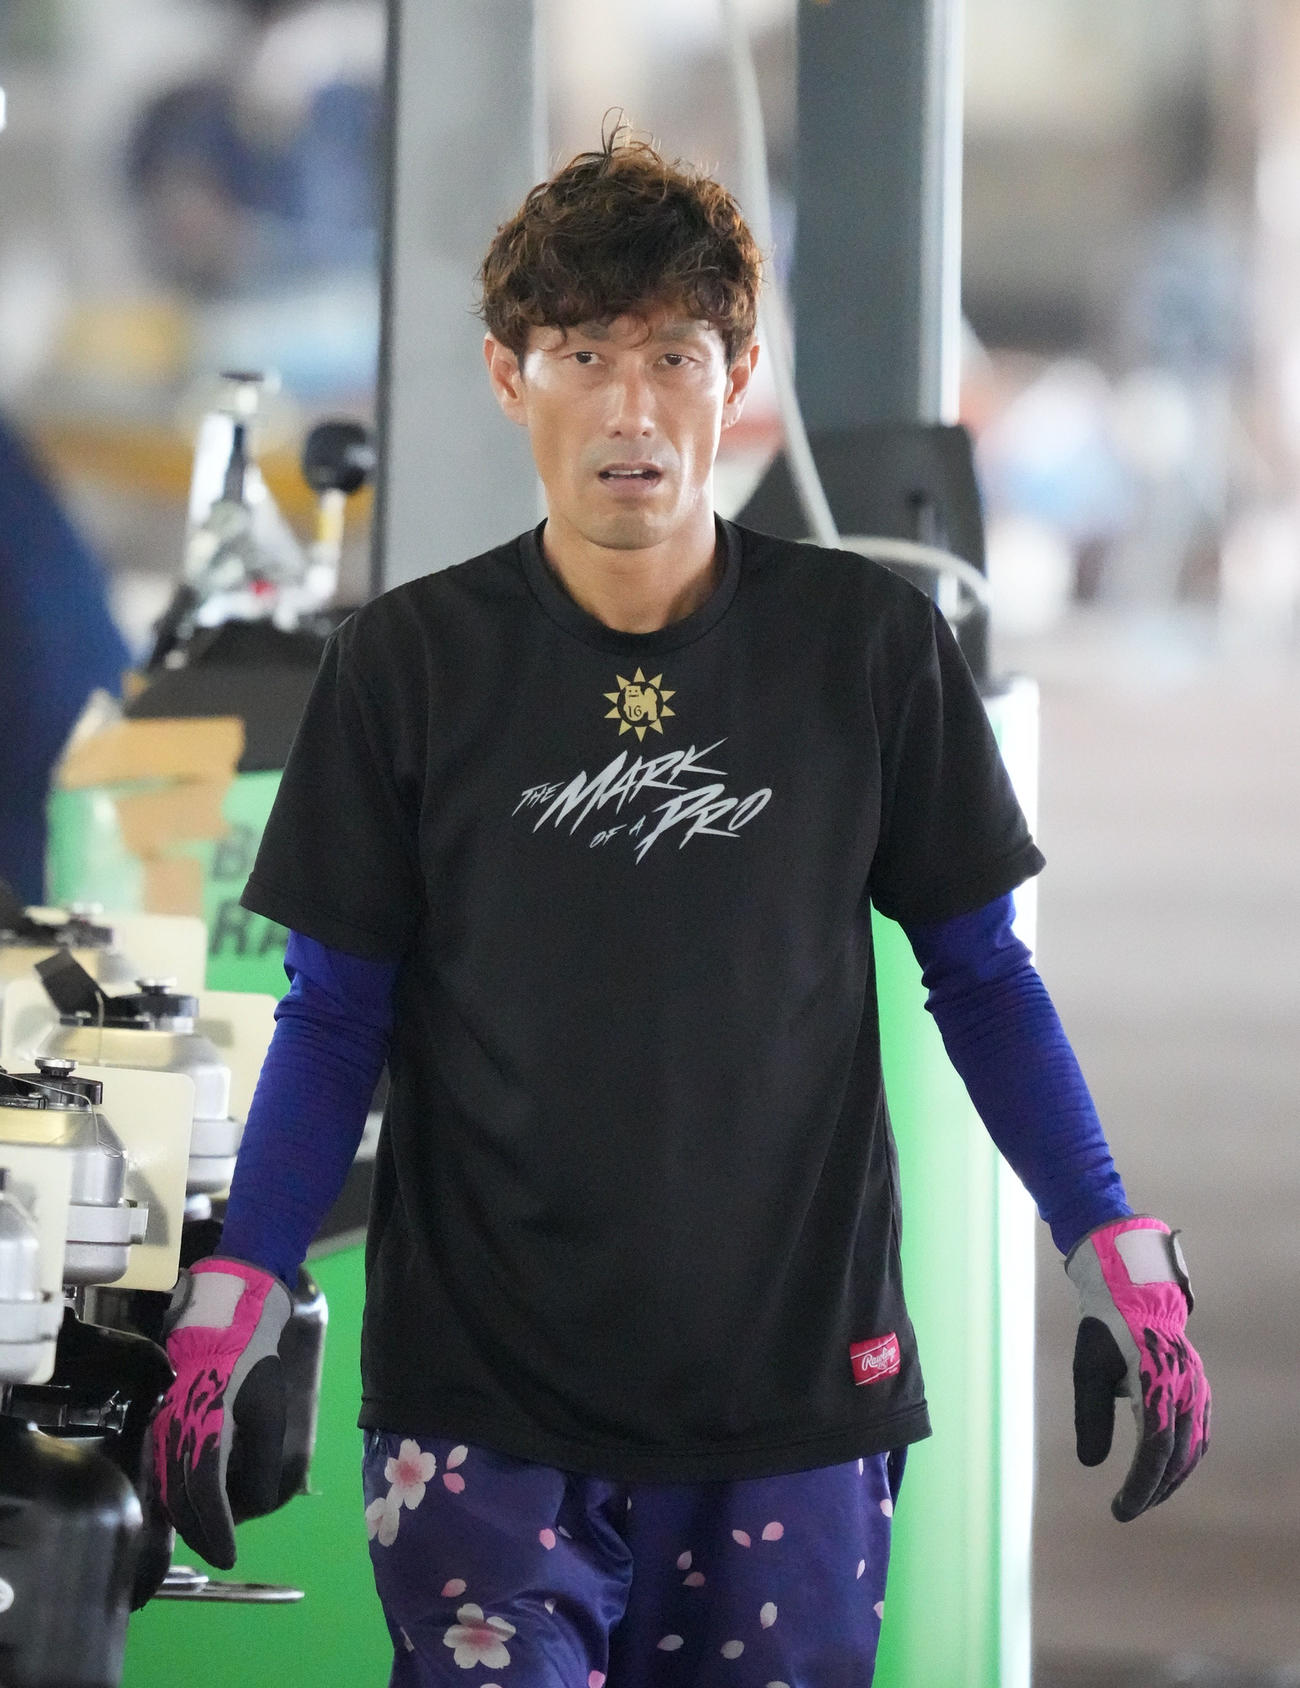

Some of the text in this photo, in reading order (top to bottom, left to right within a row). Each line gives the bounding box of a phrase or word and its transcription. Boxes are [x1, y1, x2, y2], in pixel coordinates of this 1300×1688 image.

[511, 736, 729, 837] THE MARK
[589, 783, 773, 866] OF A PRO
